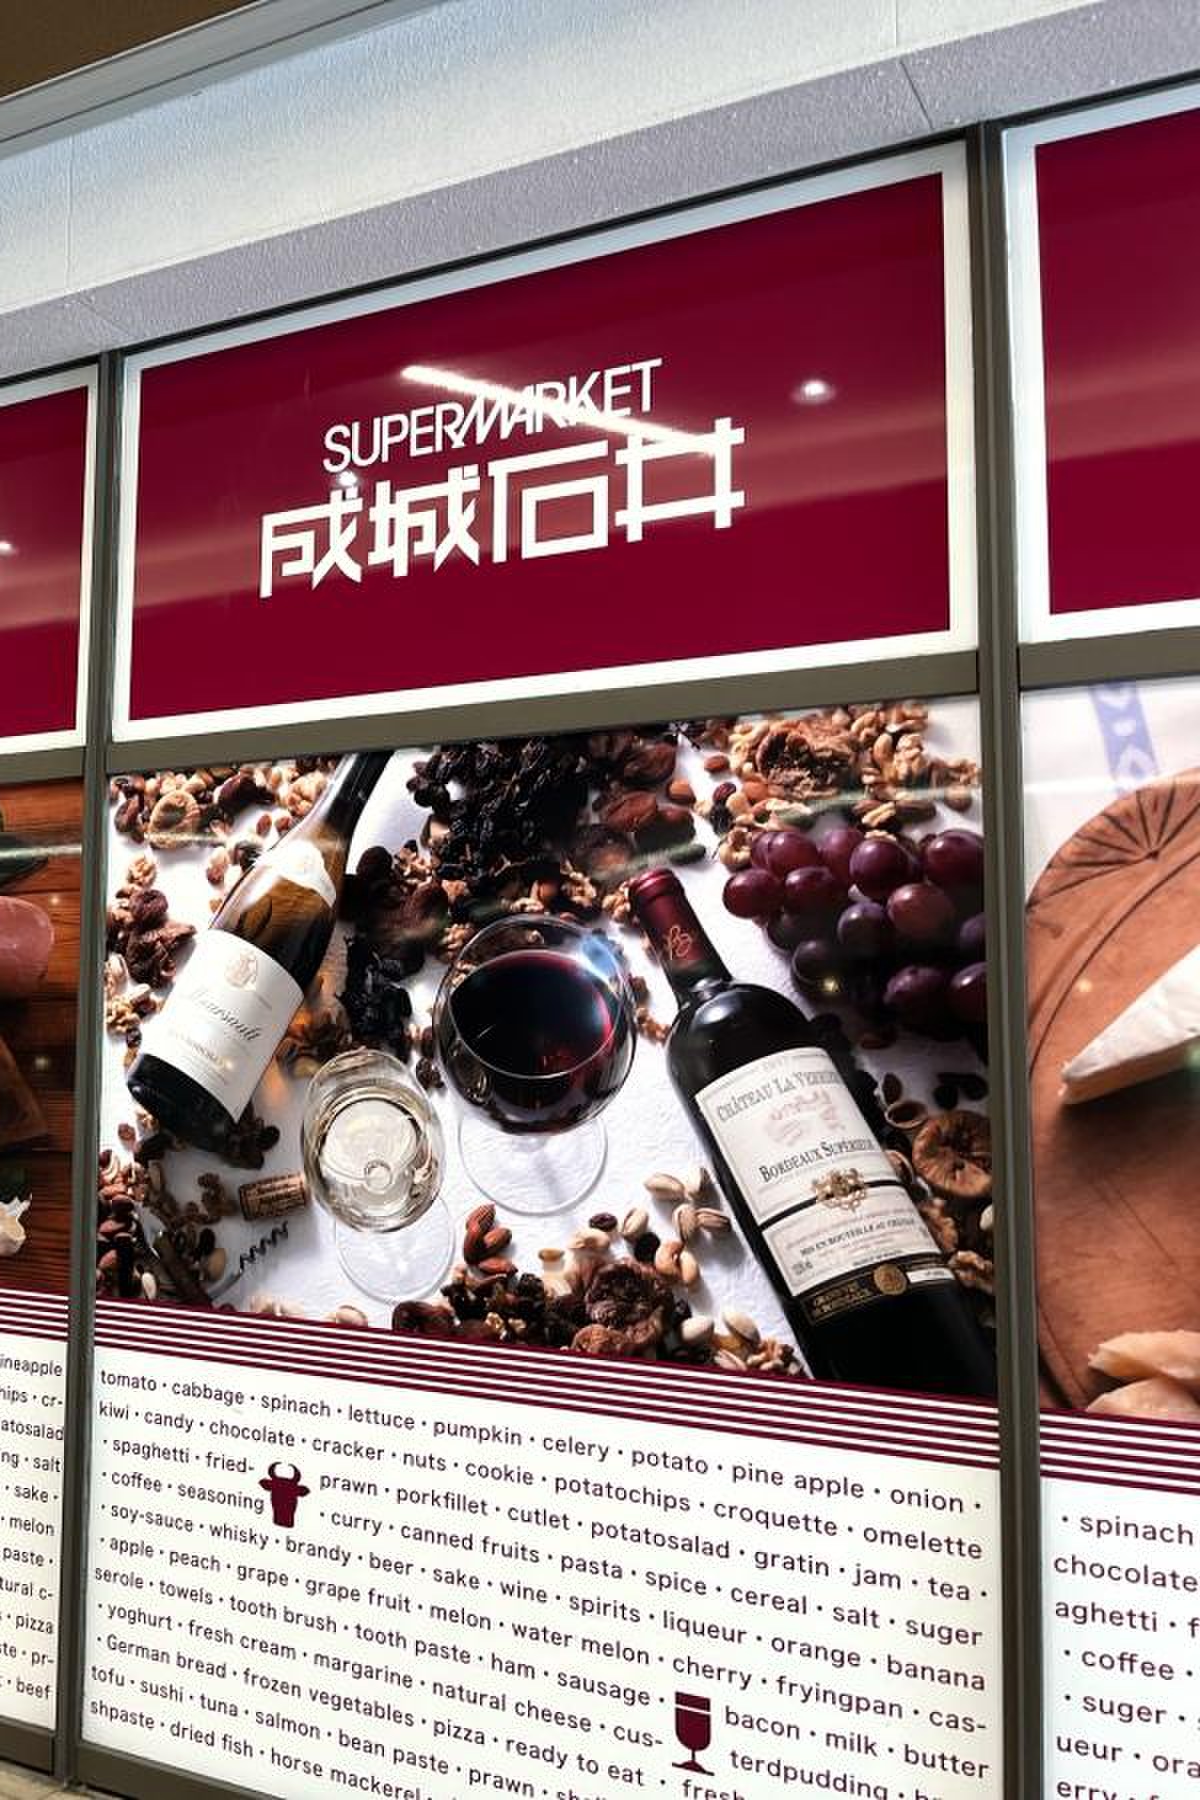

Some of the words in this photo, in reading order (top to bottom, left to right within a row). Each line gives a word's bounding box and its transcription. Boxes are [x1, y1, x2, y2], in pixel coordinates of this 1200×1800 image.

[322, 358, 662, 474] SUPERMARKET
[259, 417, 745, 598] 成城石井
[100, 1369, 157, 1392] tomato
[171, 1381, 245, 1407] cabbage
[260, 1393, 331, 1418] spinach
[348, 1403, 415, 1431] lettuce
[432, 1420, 522, 1446] pumpkin
[542, 1434, 609, 1463] celery
[631, 1449, 709, 1475] potato
[731, 1461, 784, 1487] pine
[793, 1474, 864, 1499] apple
[889, 1487, 964, 1514] onion
[32, 1455, 60, 1473] salt
[98, 1399, 129, 1421] kiwi
[143, 1410, 194, 1434] candy
[208, 1418, 295, 1447] chocolate
[311, 1437, 385, 1461] cracker
[402, 1452, 447, 1472] nuts
[464, 1461, 534, 1486] cookie
[554, 1476, 691, 1513] potatochips
[713, 1502, 838, 1537] croquette
[862, 1526, 983, 1560] omelette
[13, 1484, 49, 1504] sake
[8, 1516, 55, 1537] melon
[112, 1438, 189, 1464] spaghetti
[204, 1450, 255, 1473] fried-
[319, 1474, 378, 1497] prawn
[395, 1487, 488, 1517] porkfillet
[506, 1506, 570, 1531] cutlet
[590, 1520, 730, 1559] potatosalad
[753, 1550, 830, 1577] gratin
[851, 1562, 901, 1591] jam
[927, 1576, 970, 1601] tea
[1080, 1515, 1193, 1546] spinach
[1, 1546, 45, 1567] paste
[110, 1471, 162, 1493] coffee
[177, 1482, 264, 1515] seasoning
[330, 1511, 383, 1537] curry
[400, 1524, 474, 1551] canned
[481, 1535, 540, 1564] fruits
[560, 1554, 623, 1580] pasta
[644, 1570, 707, 1596] spice
[730, 1586, 807, 1615] cereal
[832, 1605, 880, 1629] salt
[905, 1618, 983, 1646] suger
[1053, 1554, 1198, 1592] chocolate
[15, 1612, 53, 1635] pizza
[108, 1536, 154, 1559] apple
[168, 1550, 221, 1573] peach
[236, 1564, 289, 1588] grape
[305, 1578, 361, 1603] grape
[367, 1586, 411, 1614] fruit
[429, 1604, 491, 1631] melon
[511, 1622, 573, 1648] water
[580, 1637, 650, 1665] melon
[672, 1654, 753, 1691] cherry
[775, 1674, 903, 1720] fryingpan
[928, 1710, 988, 1733] cas-
[1055, 1601, 1157, 1632] aghetti
[1081, 1650, 1174, 1680] coffee
[15, 1676, 50, 1700] beef
[106, 1603, 173, 1631] yoghurt
[187, 1618, 233, 1645] fresh
[239, 1634, 296, 1661] cream
[313, 1652, 413, 1689] margarine
[432, 1681, 507, 1712] natural
[514, 1699, 592, 1733] cheese
[612, 1724, 663, 1748] cus-
[729, 1749, 888, 1800] terdpudding
[106, 1632, 170, 1665] German
[175, 1650, 227, 1679] bread
[242, 1666, 301, 1699] frozen
[308, 1687, 415, 1727] vegetables
[432, 1717, 485, 1745] pizza
[505, 1738, 568, 1770] ready
[575, 1752, 599, 1775] to
[607, 1764, 645, 1787] eat
[1082, 1695, 1167, 1724] suger
[89, 1699, 155, 1731] shpaste
[169, 1720, 215, 1747] dried
[221, 1732, 254, 1758] fish
[270, 1745, 323, 1777] horse
[329, 1768, 420, 1800] mackerel
[91, 1665, 125, 1687] tofu
[139, 1679, 184, 1703] sushi
[199, 1692, 238, 1717] tuna
[255, 1710, 321, 1740] salmon
[338, 1727, 385, 1758] bean
[392, 1747, 449, 1775] paste
[468, 1767, 535, 1799] prawn
[1056, 1735, 1123, 1762] ueur
